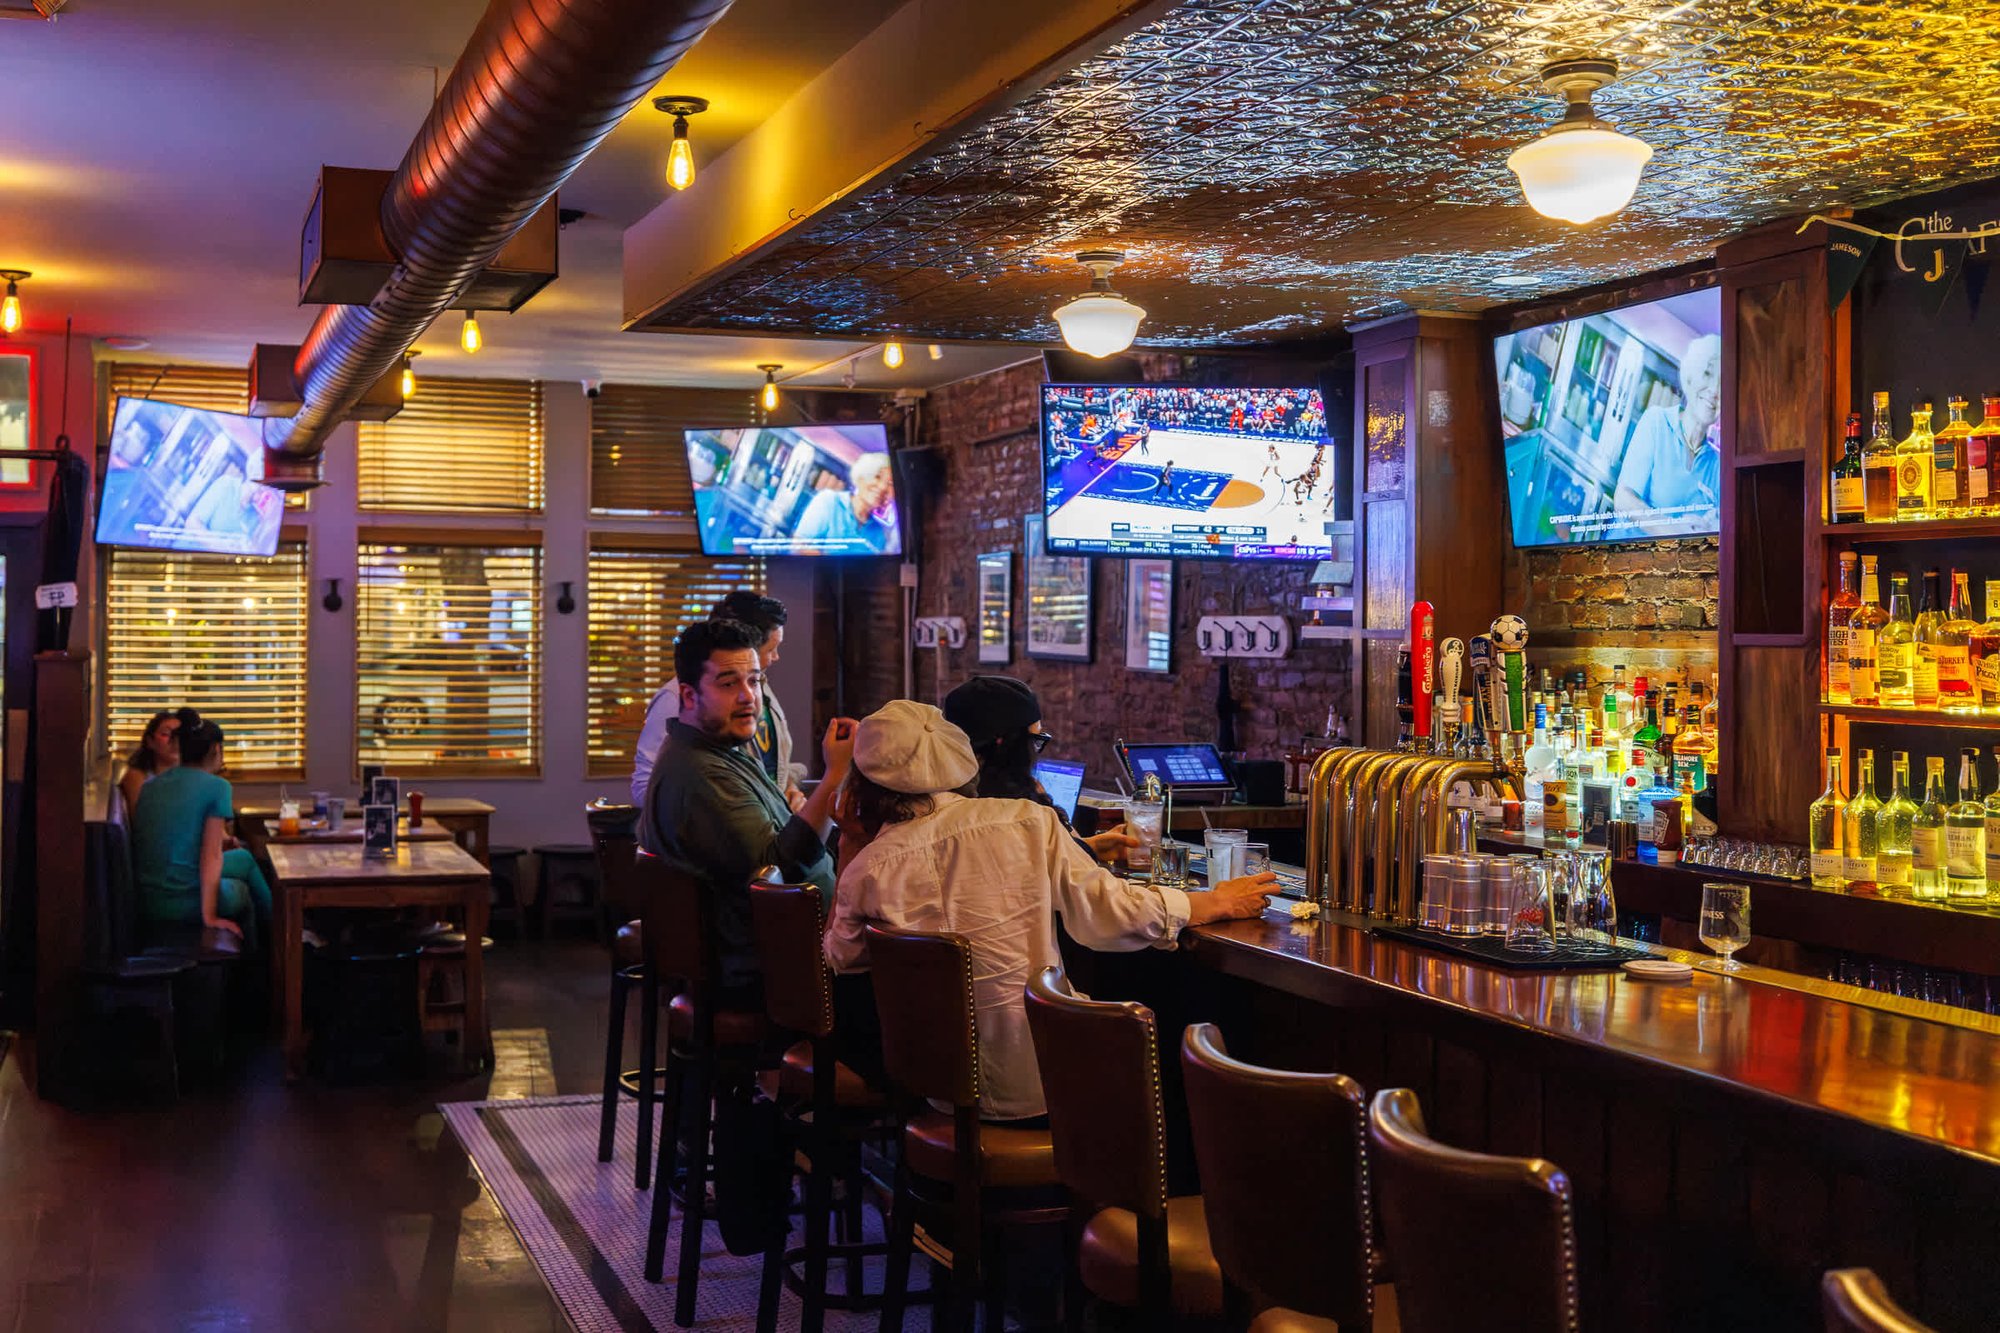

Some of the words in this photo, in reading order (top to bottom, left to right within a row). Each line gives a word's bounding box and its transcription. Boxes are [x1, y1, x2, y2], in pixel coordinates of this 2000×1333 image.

[1927, 211, 1953, 233] the
[1830, 243, 1861, 258] JAMESON
[1421, 646, 1433, 694] Carlsberg
